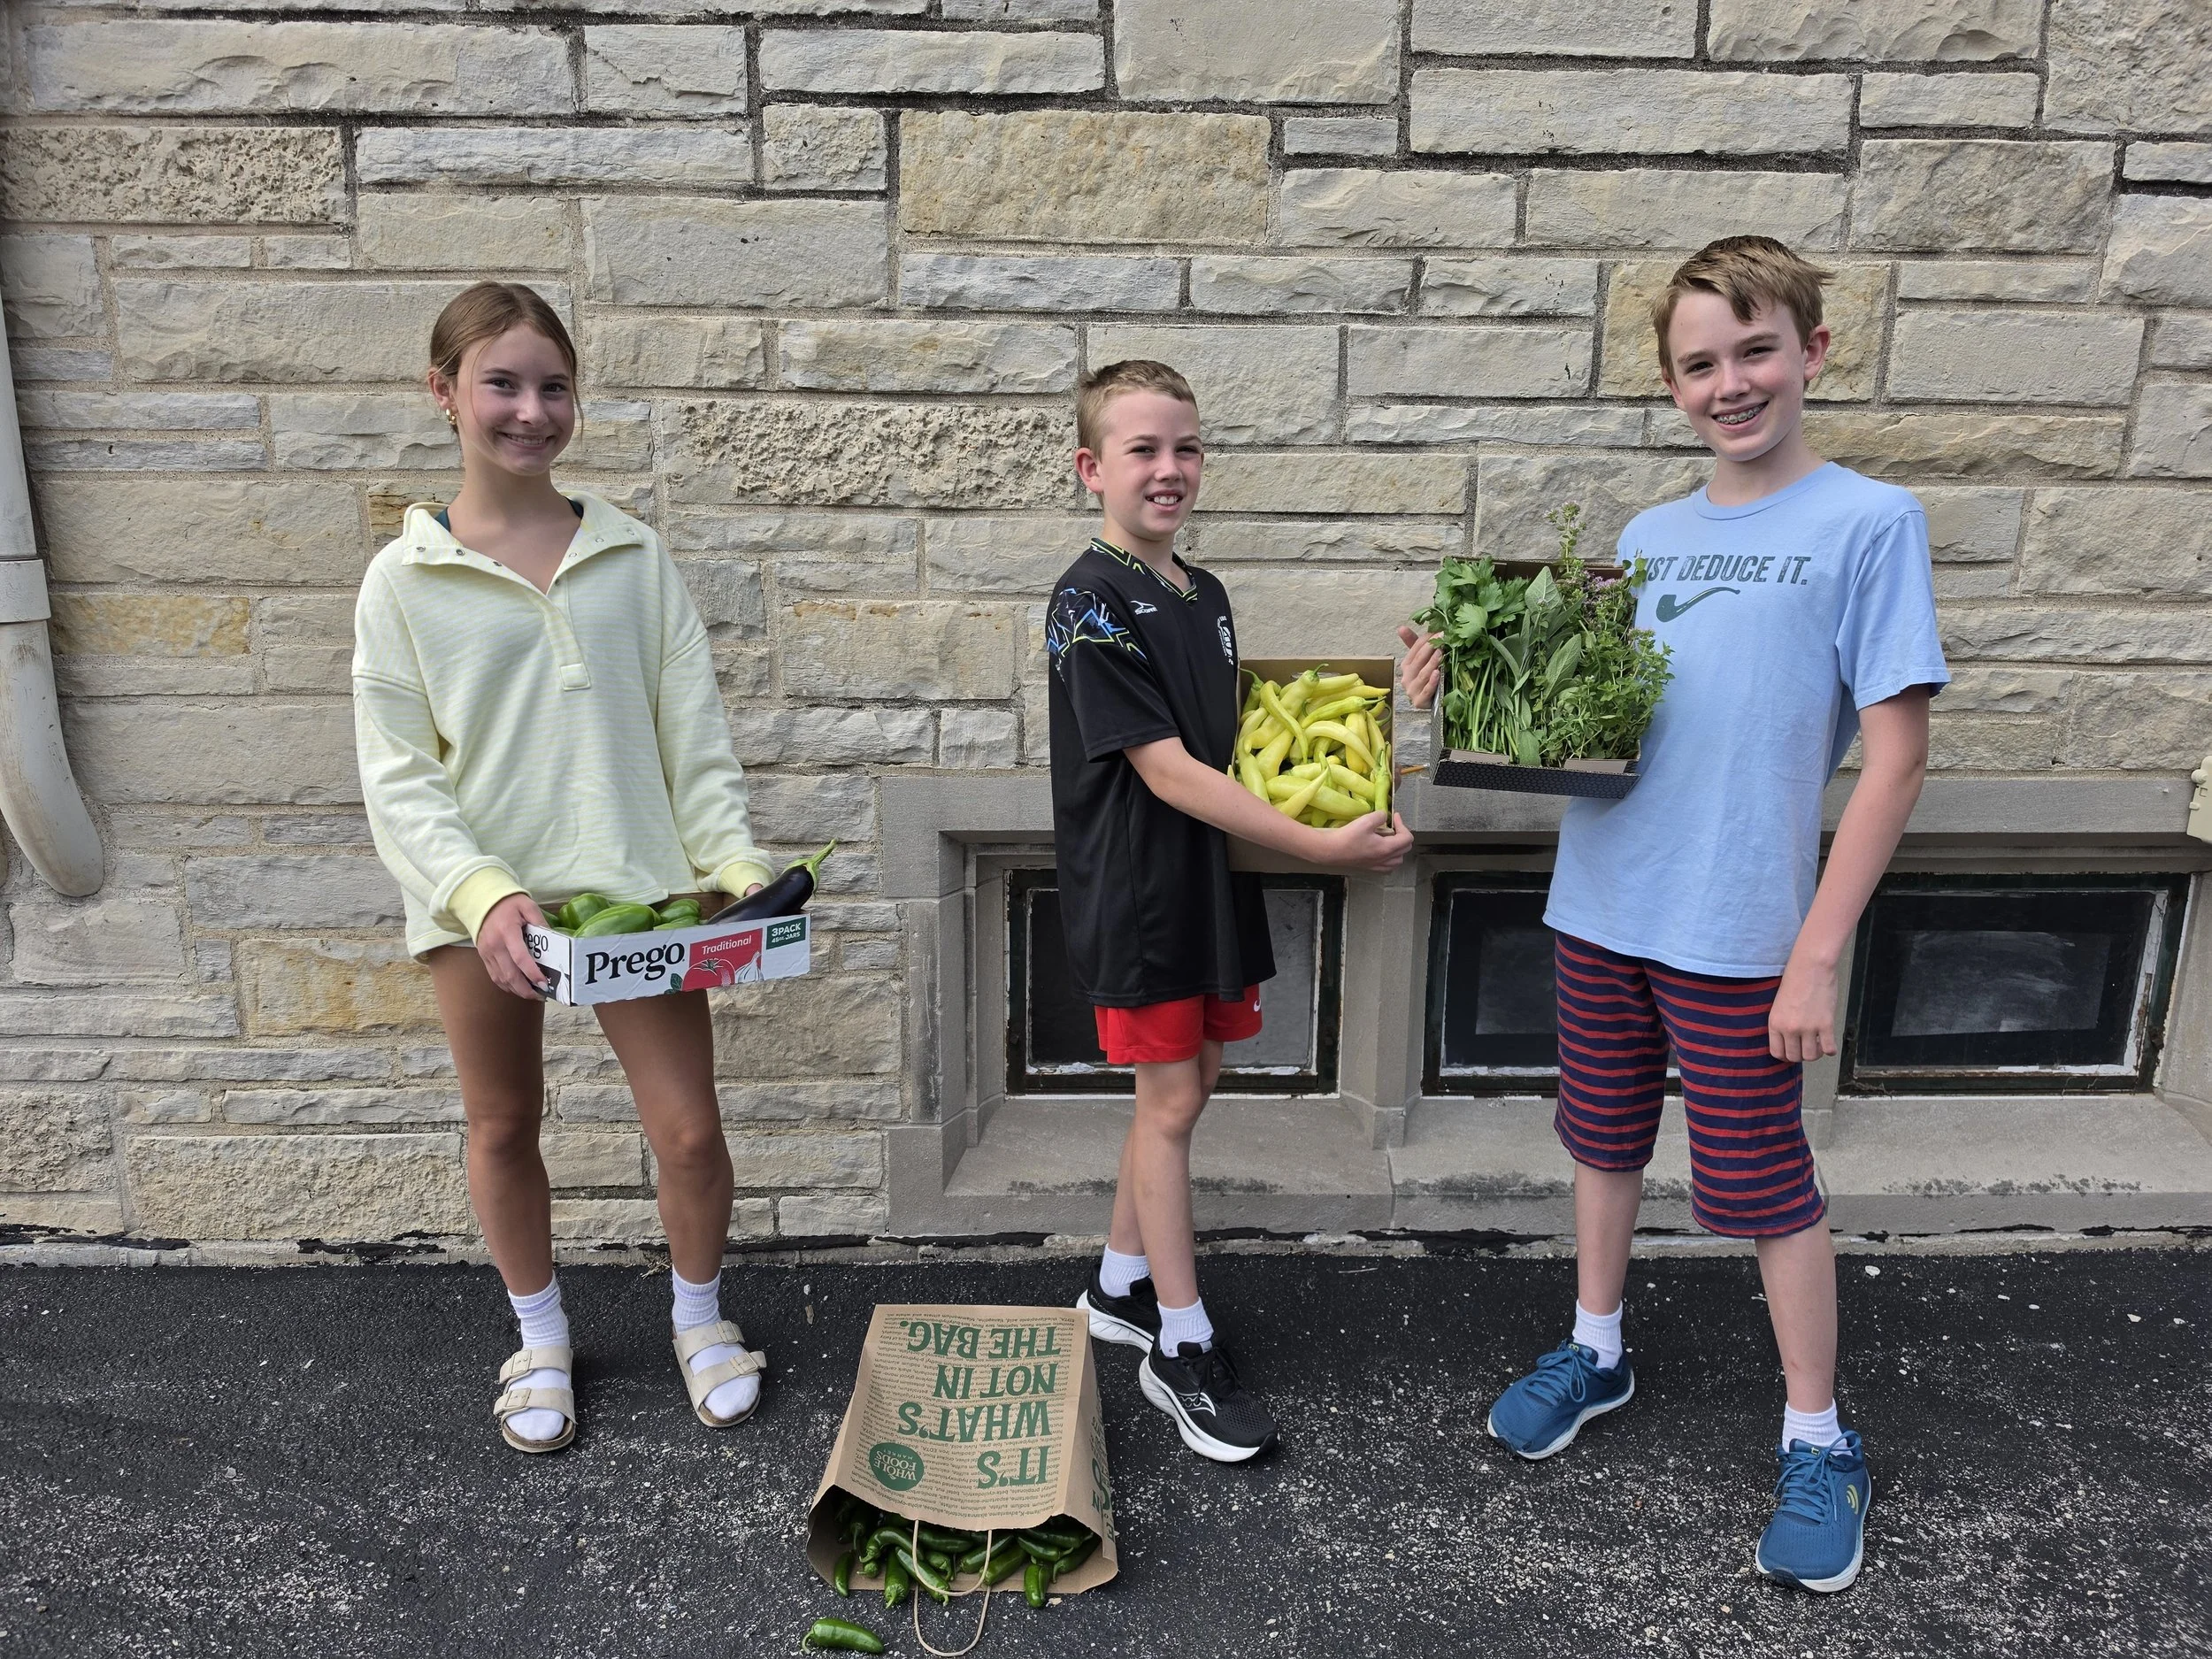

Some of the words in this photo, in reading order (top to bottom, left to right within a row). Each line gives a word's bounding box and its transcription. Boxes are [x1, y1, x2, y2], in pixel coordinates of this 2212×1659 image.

[1677, 555, 1776, 582] DEDUCE
[1777, 557, 1811, 585] IT.
[772, 922, 802, 937] 3PACK
[785, 931, 801, 940] JARS
[526, 933, 549, 959] ego
[702, 935, 752, 956] Traditional
[585, 942, 685, 985] Prego
[900, 1321, 979, 1359] BAG.
[988, 1326, 1061, 1359] THE
[932, 1364, 975, 1400] IN
[979, 1363, 1058, 1398] NOT
[895, 1401, 1052, 1442] WHAT'S
[873, 1457, 917, 1481] WHOLE
[876, 1450, 917, 1471] FOODS
[883, 1448, 913, 1460] MARKET
[977, 1446, 1050, 1489] IT'S
